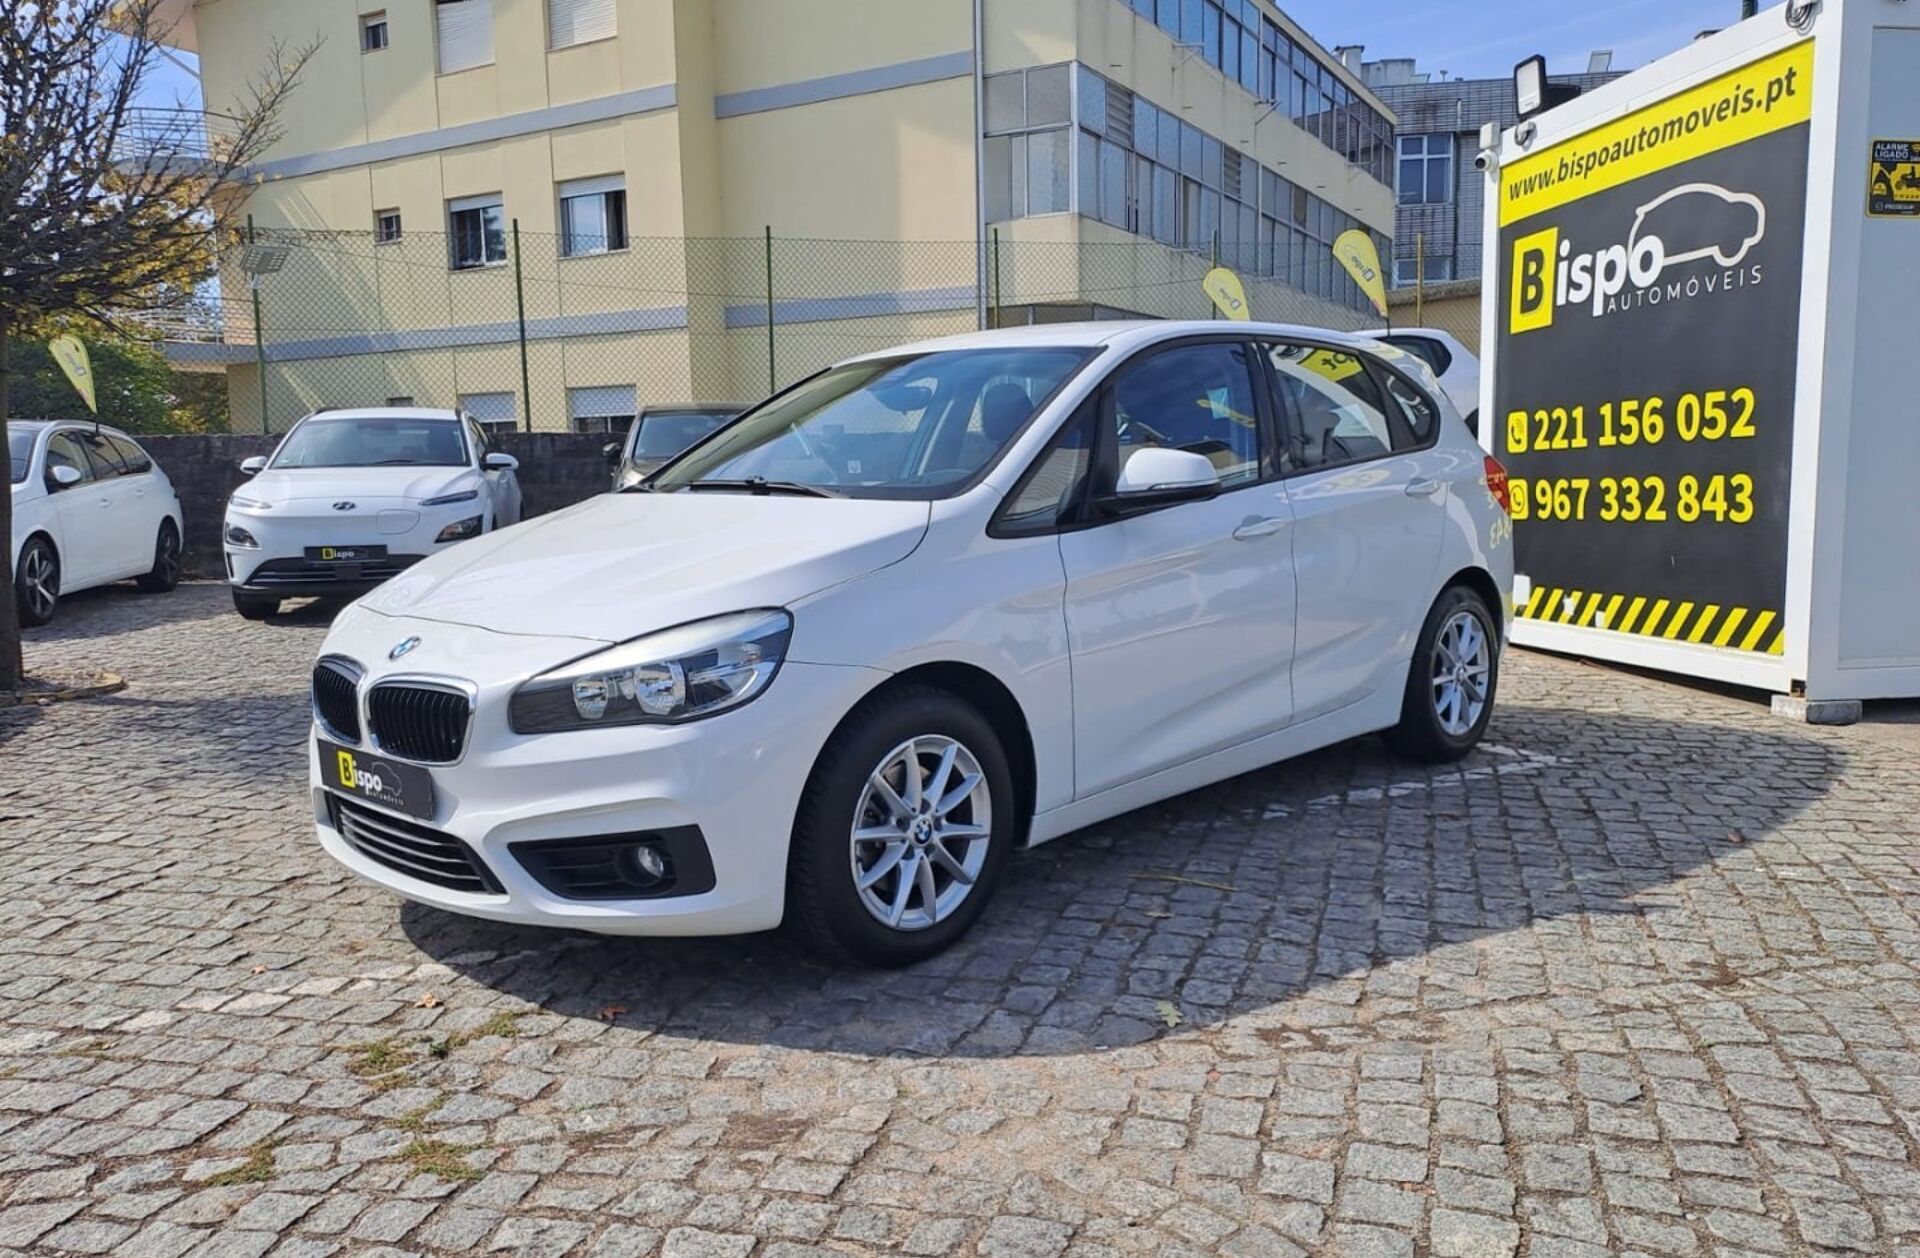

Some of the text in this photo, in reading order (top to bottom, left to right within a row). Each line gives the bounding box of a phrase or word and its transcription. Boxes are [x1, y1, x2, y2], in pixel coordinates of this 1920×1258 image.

[1508, 66, 1797, 201] www.bispoautomoveis.pt
[1875, 150, 1909, 158] LIGADO
[1519, 235, 1665, 317] Bispo
[1606, 264, 1762, 314] AUTOMÓVEIS
[1533, 387, 1755, 450] 221 156 052
[1535, 473, 1753, 523] 967 332 843
[341, 757, 383, 795] Bispo
